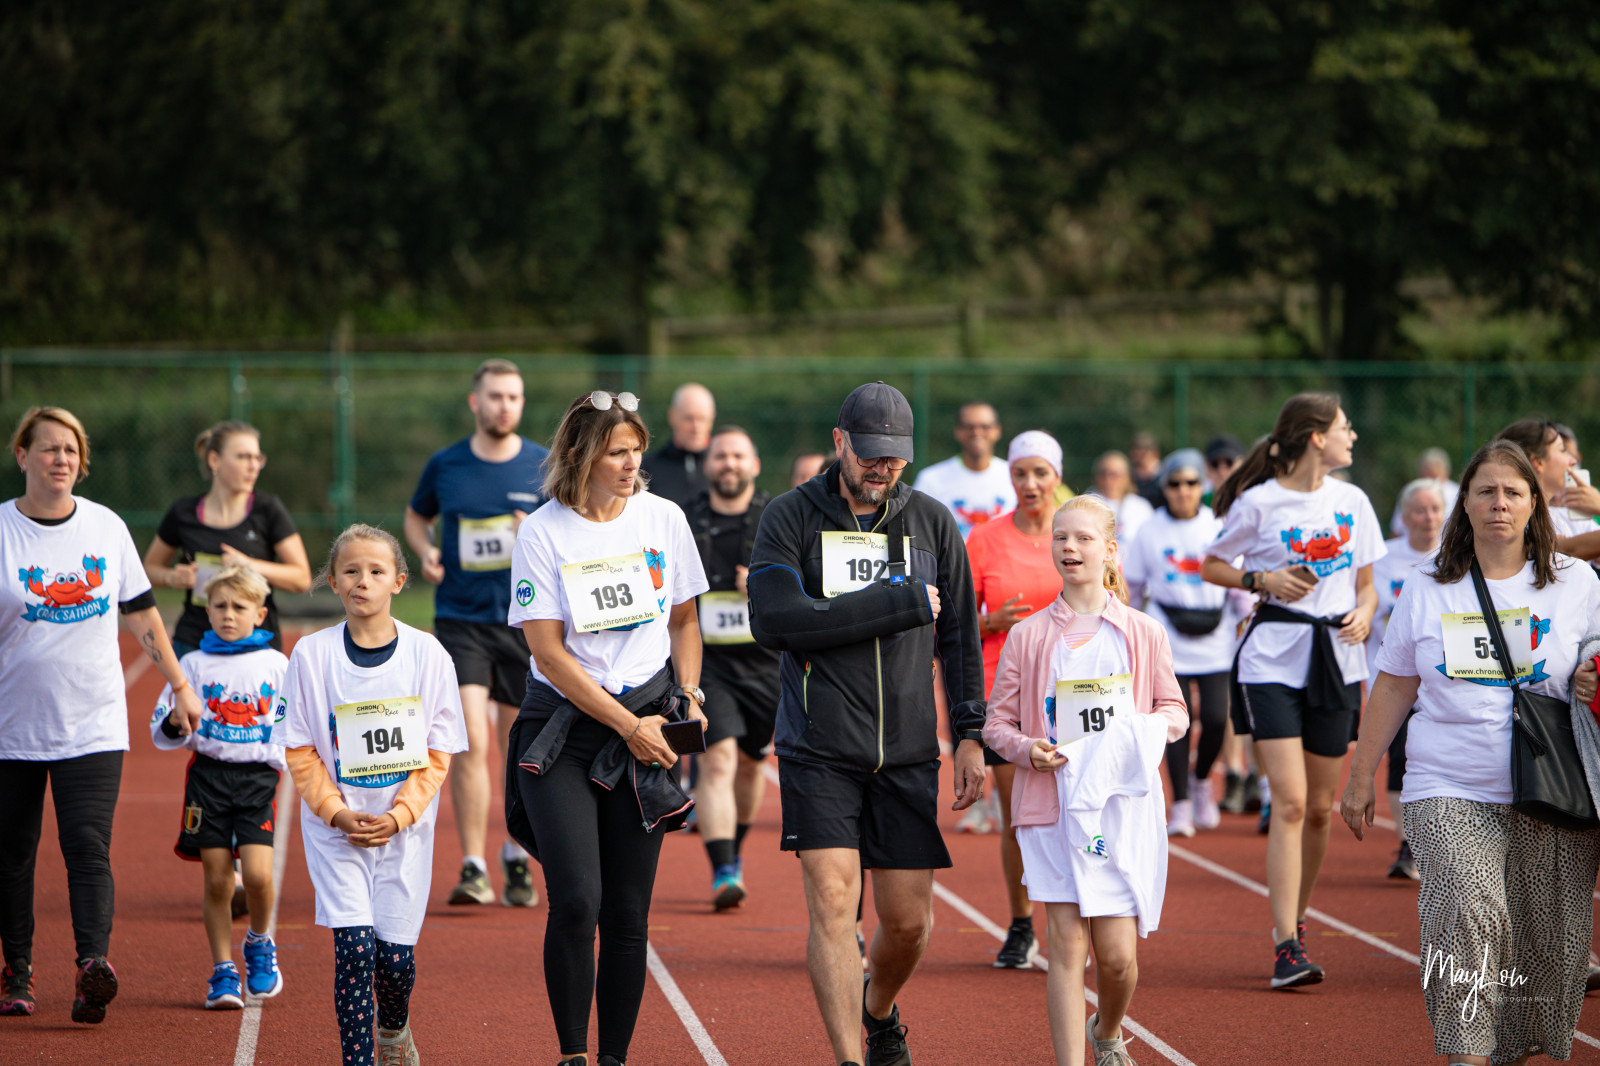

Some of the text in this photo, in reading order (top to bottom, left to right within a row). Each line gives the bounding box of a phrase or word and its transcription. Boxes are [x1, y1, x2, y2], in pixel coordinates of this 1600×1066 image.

[846, 558, 887, 581] 192
[590, 583, 634, 611] 193
[582, 611, 654, 630] www.chronorace.be
[361, 726, 405, 755] 194
[348, 758, 422, 774] www.chronorace.be
